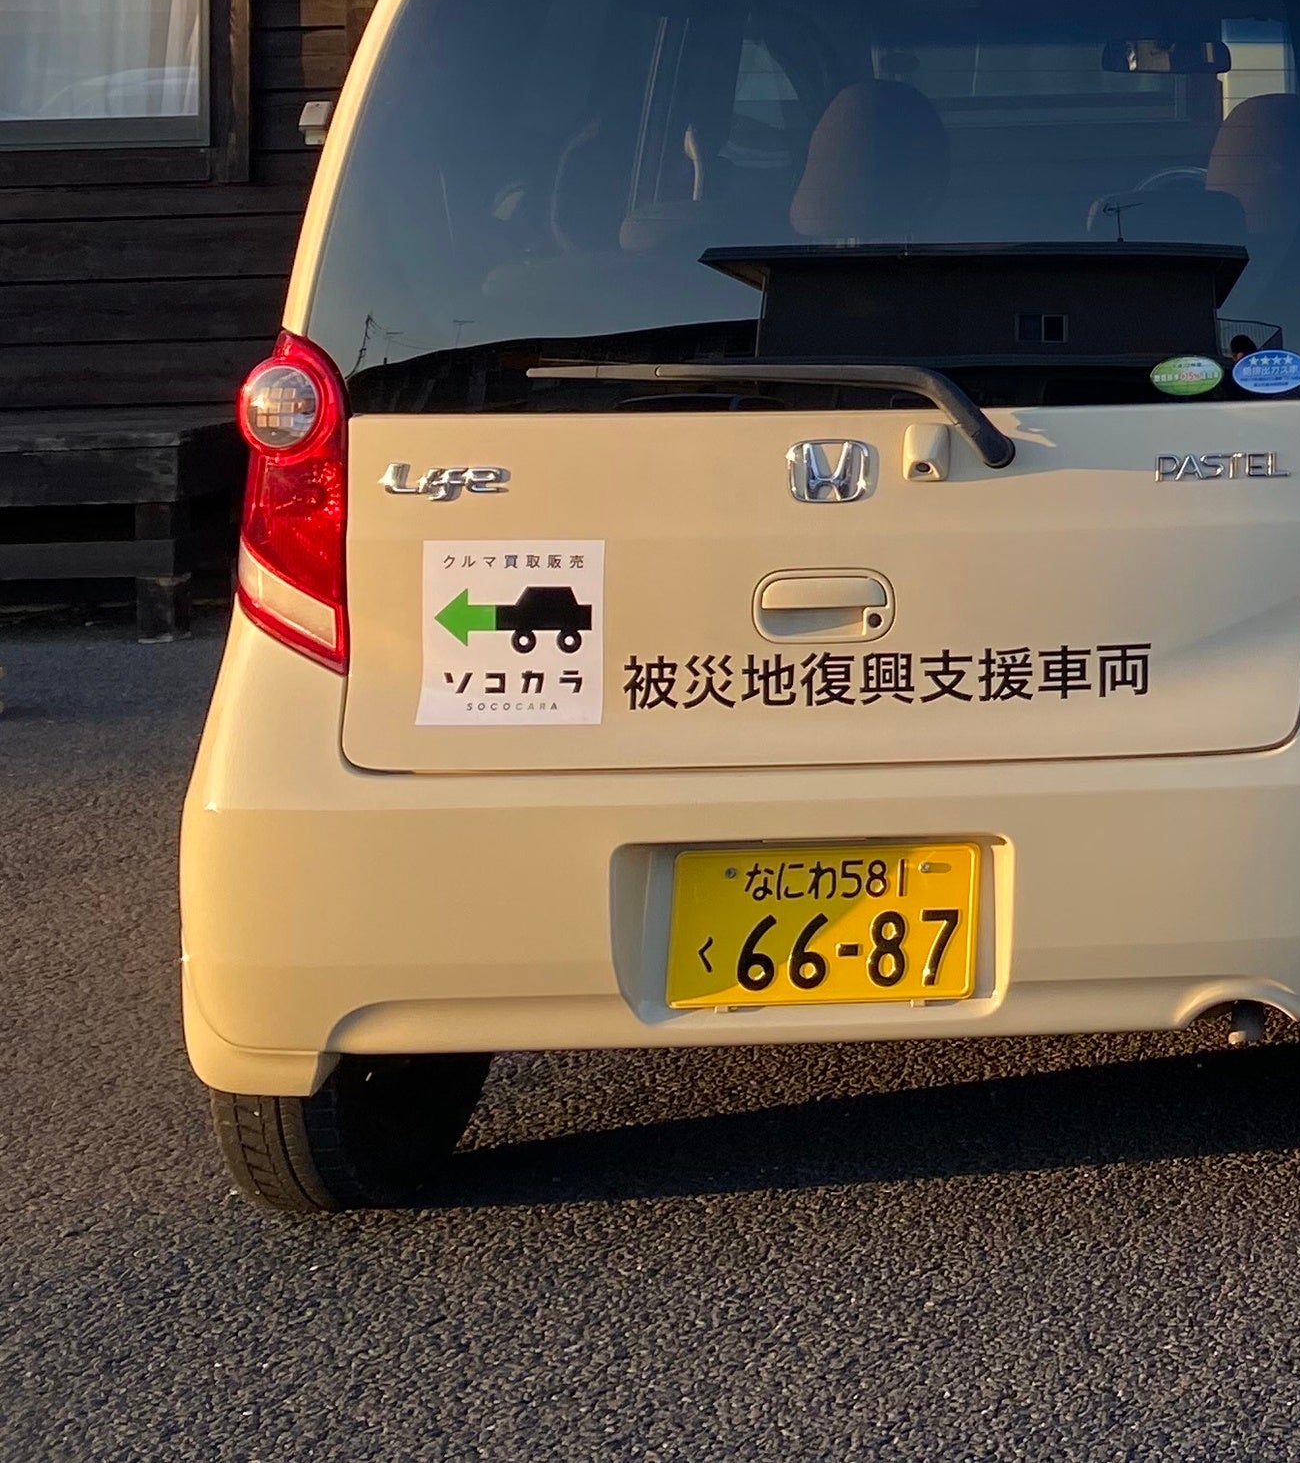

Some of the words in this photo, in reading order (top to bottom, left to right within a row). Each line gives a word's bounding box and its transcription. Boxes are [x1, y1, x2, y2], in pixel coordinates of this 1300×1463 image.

[1154, 451, 1291, 482] PASTEL
[443, 554, 585, 570] クルマ買取販売
[443, 669, 584, 695] ソコカラ
[622, 642, 1153, 711] 被災地復興支援車両
[466, 702, 558, 712] SOCOCARA
